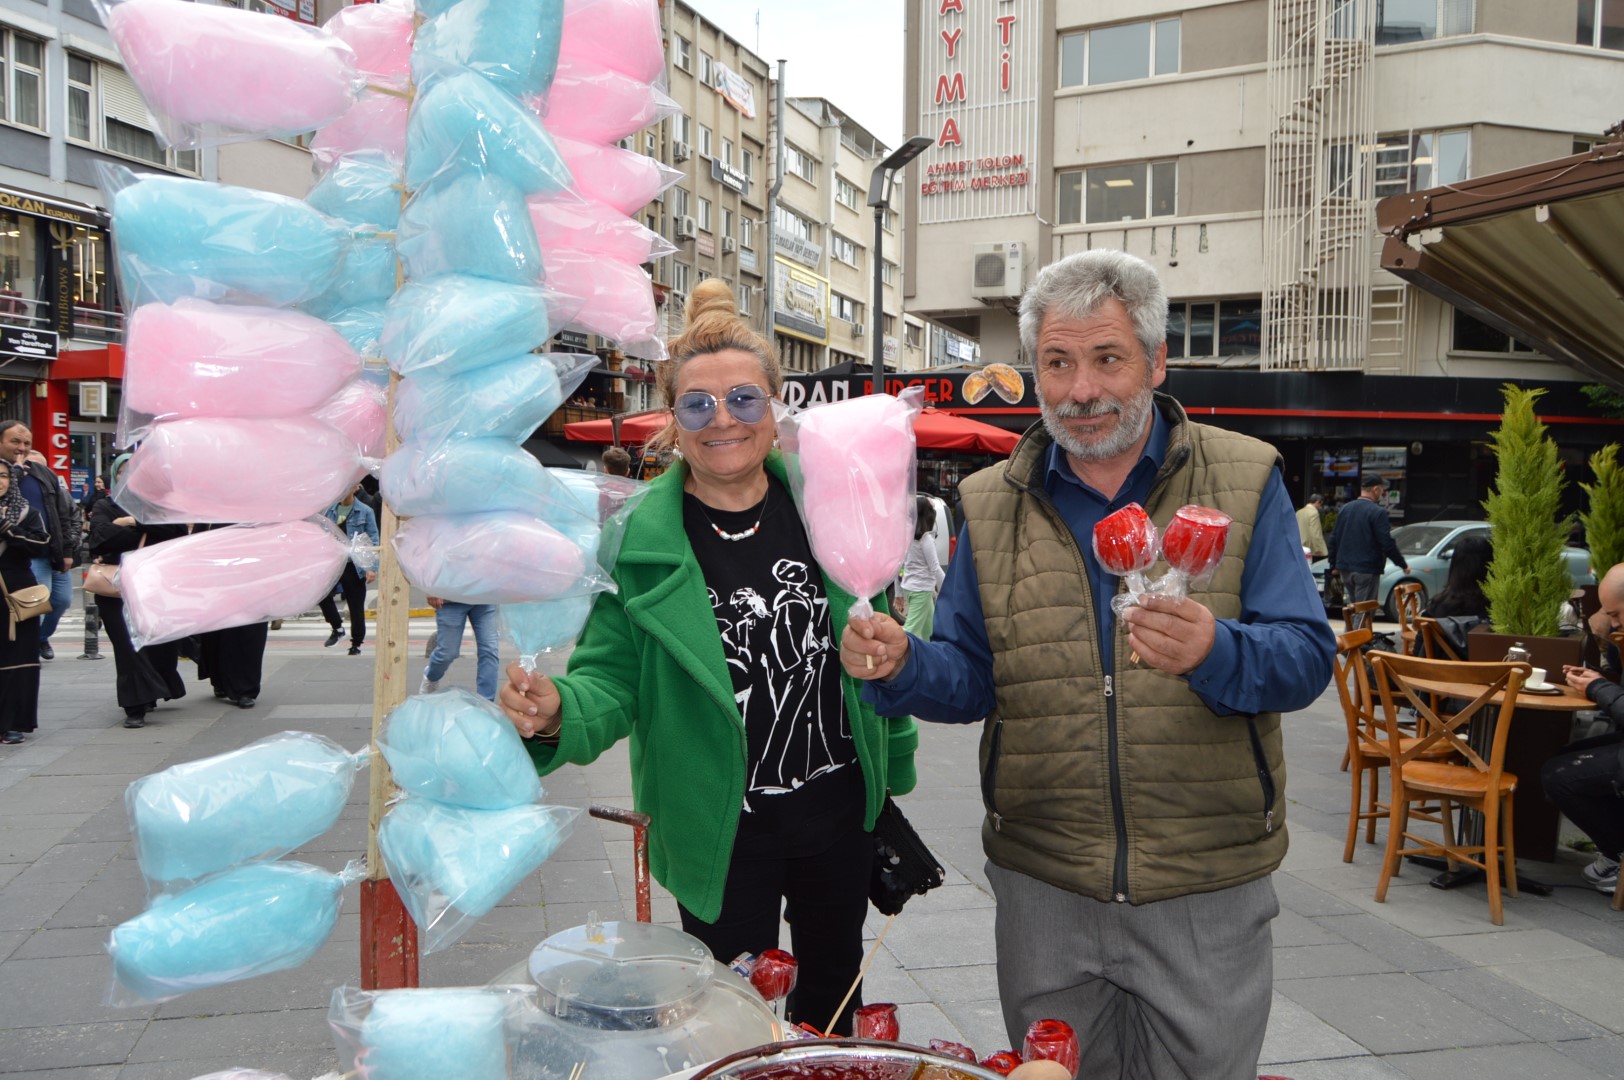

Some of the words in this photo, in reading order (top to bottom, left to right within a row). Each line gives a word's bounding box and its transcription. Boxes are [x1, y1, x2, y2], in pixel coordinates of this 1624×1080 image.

[927, 160, 972, 175] AHMET
[977, 154, 1023, 169] TOLON
[921, 175, 967, 196] EĞİTİM
[970, 168, 1030, 190] MERKEZİ
